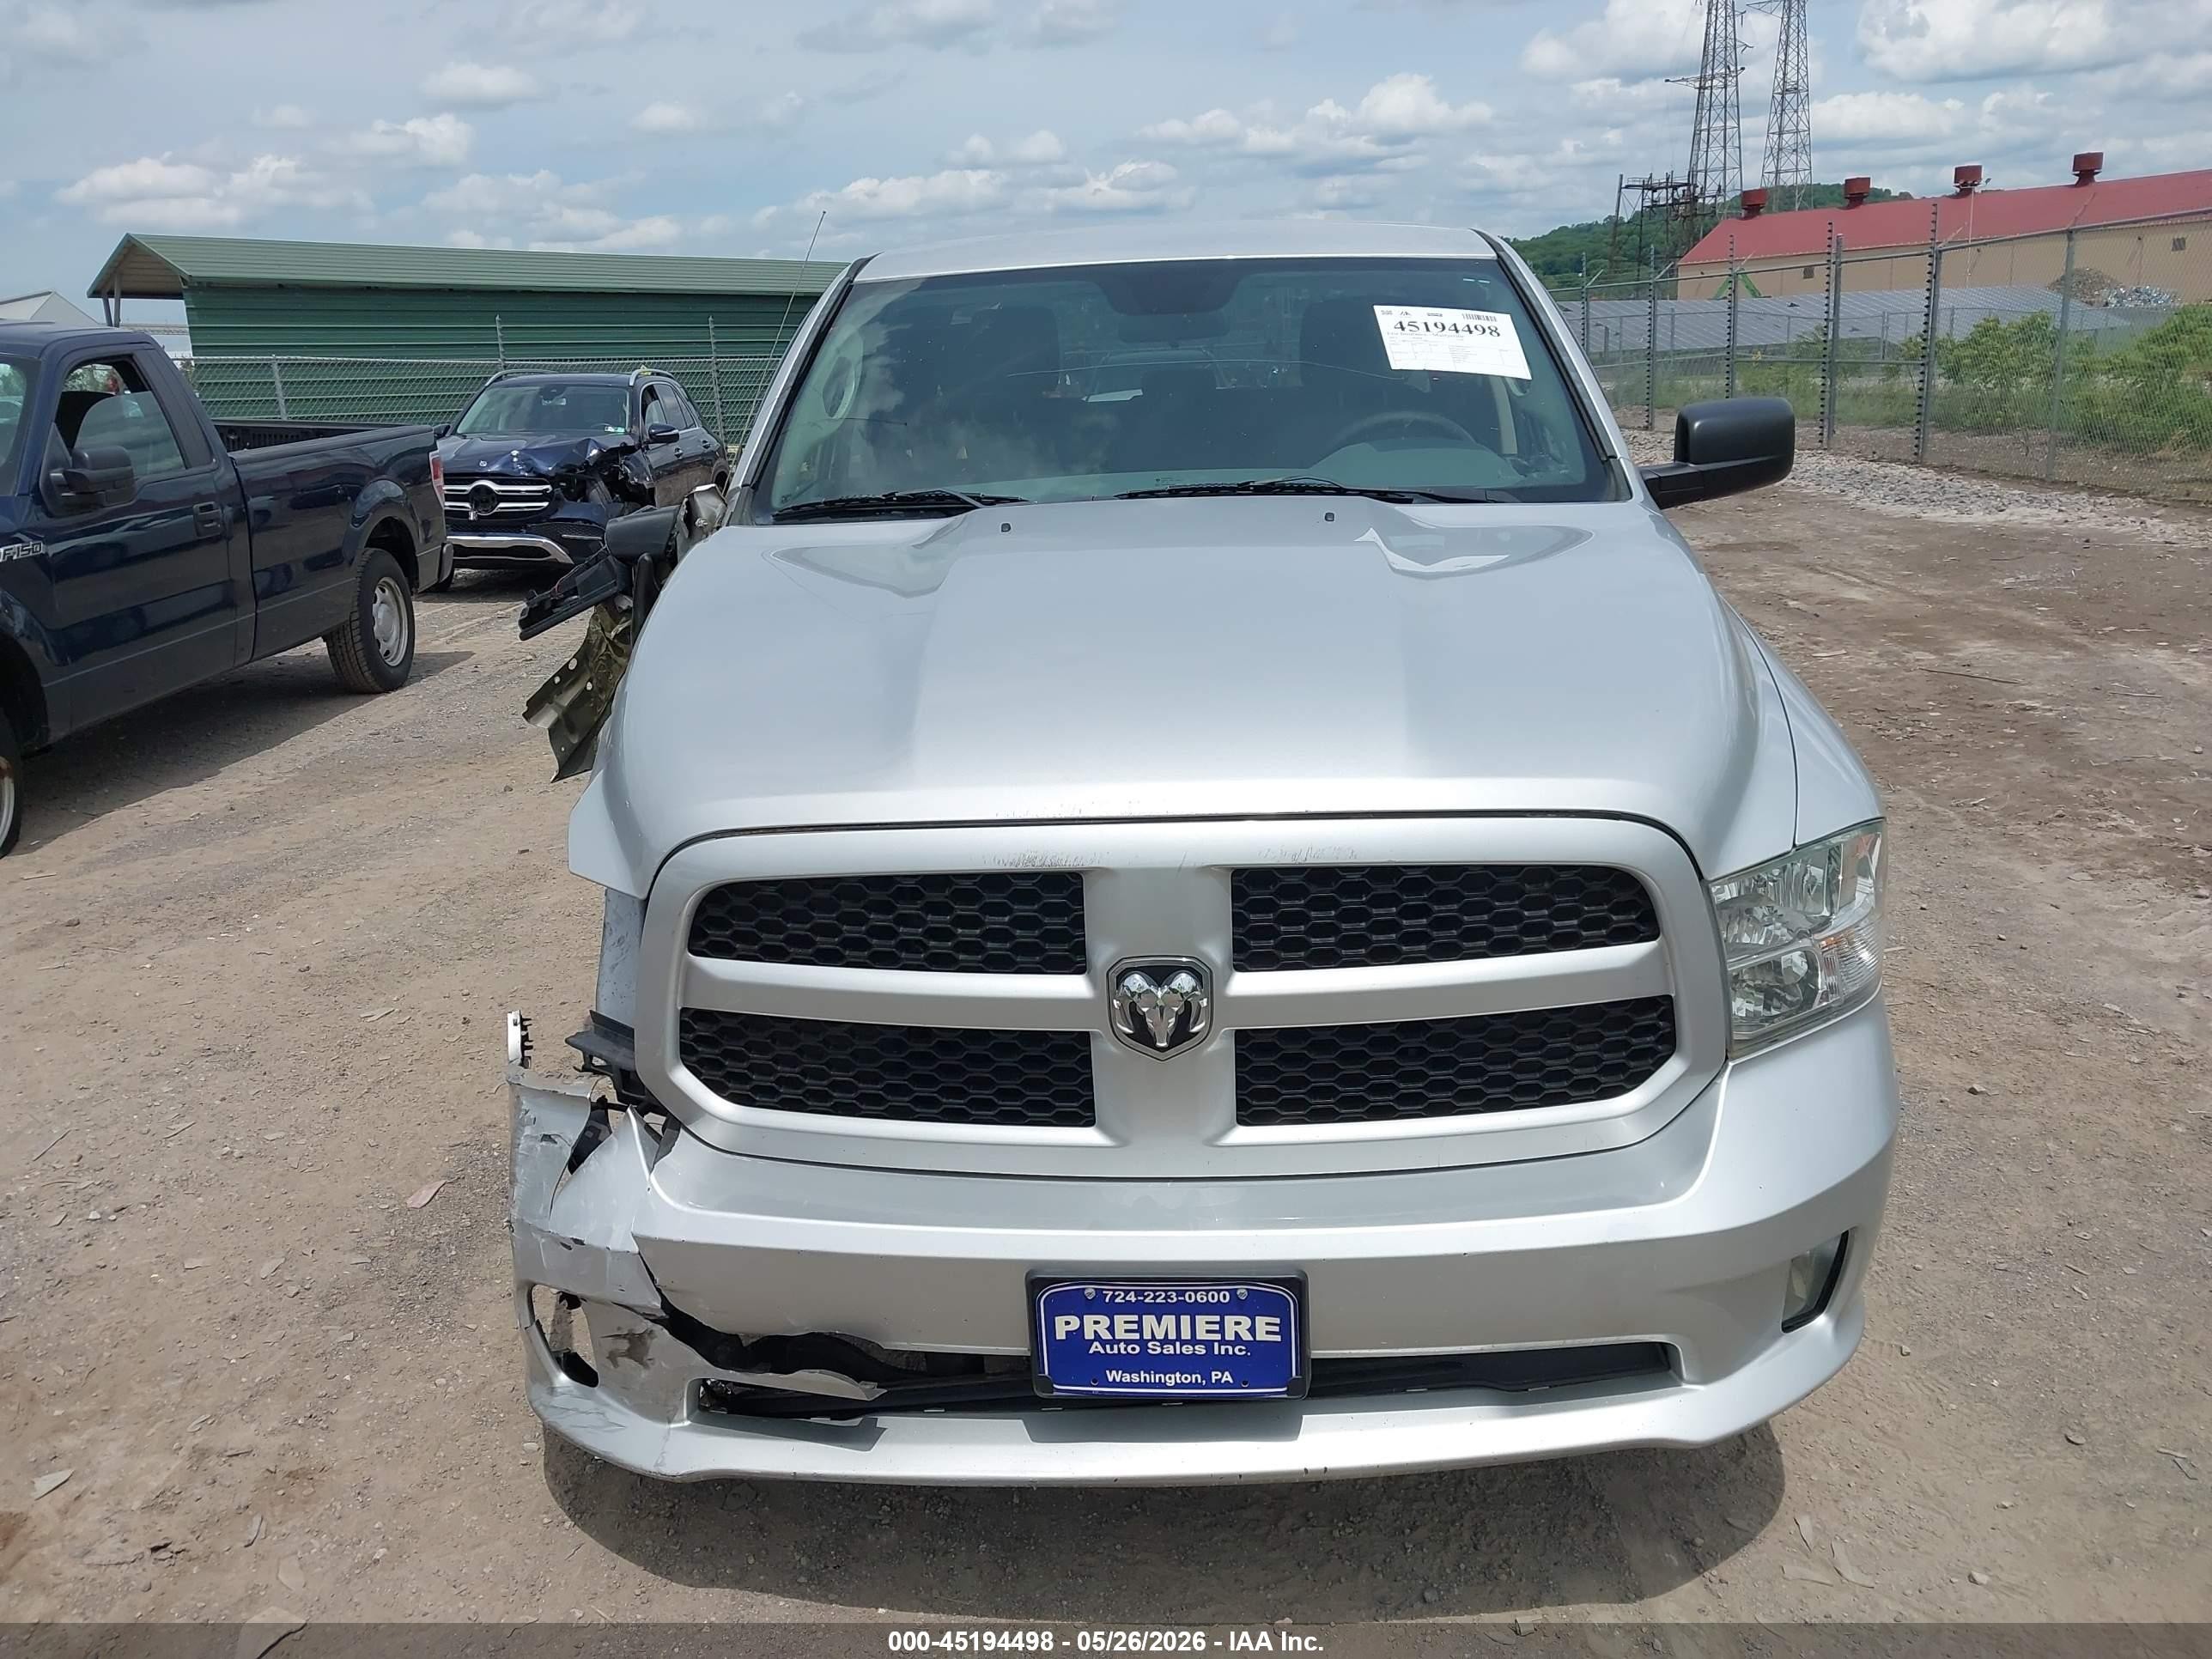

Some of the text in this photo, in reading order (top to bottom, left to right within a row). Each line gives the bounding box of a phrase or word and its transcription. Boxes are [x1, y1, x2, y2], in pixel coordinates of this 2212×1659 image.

[1394, 320, 1501, 337] 45194498
[1103, 1291, 1231, 1303] 724-223-0600
[1054, 1315, 1281, 1341] PREMIERE
[1089, 1342, 1250, 1356] Auto Sales Inc.
[1106, 1370, 1233, 1386] Washington, PA
